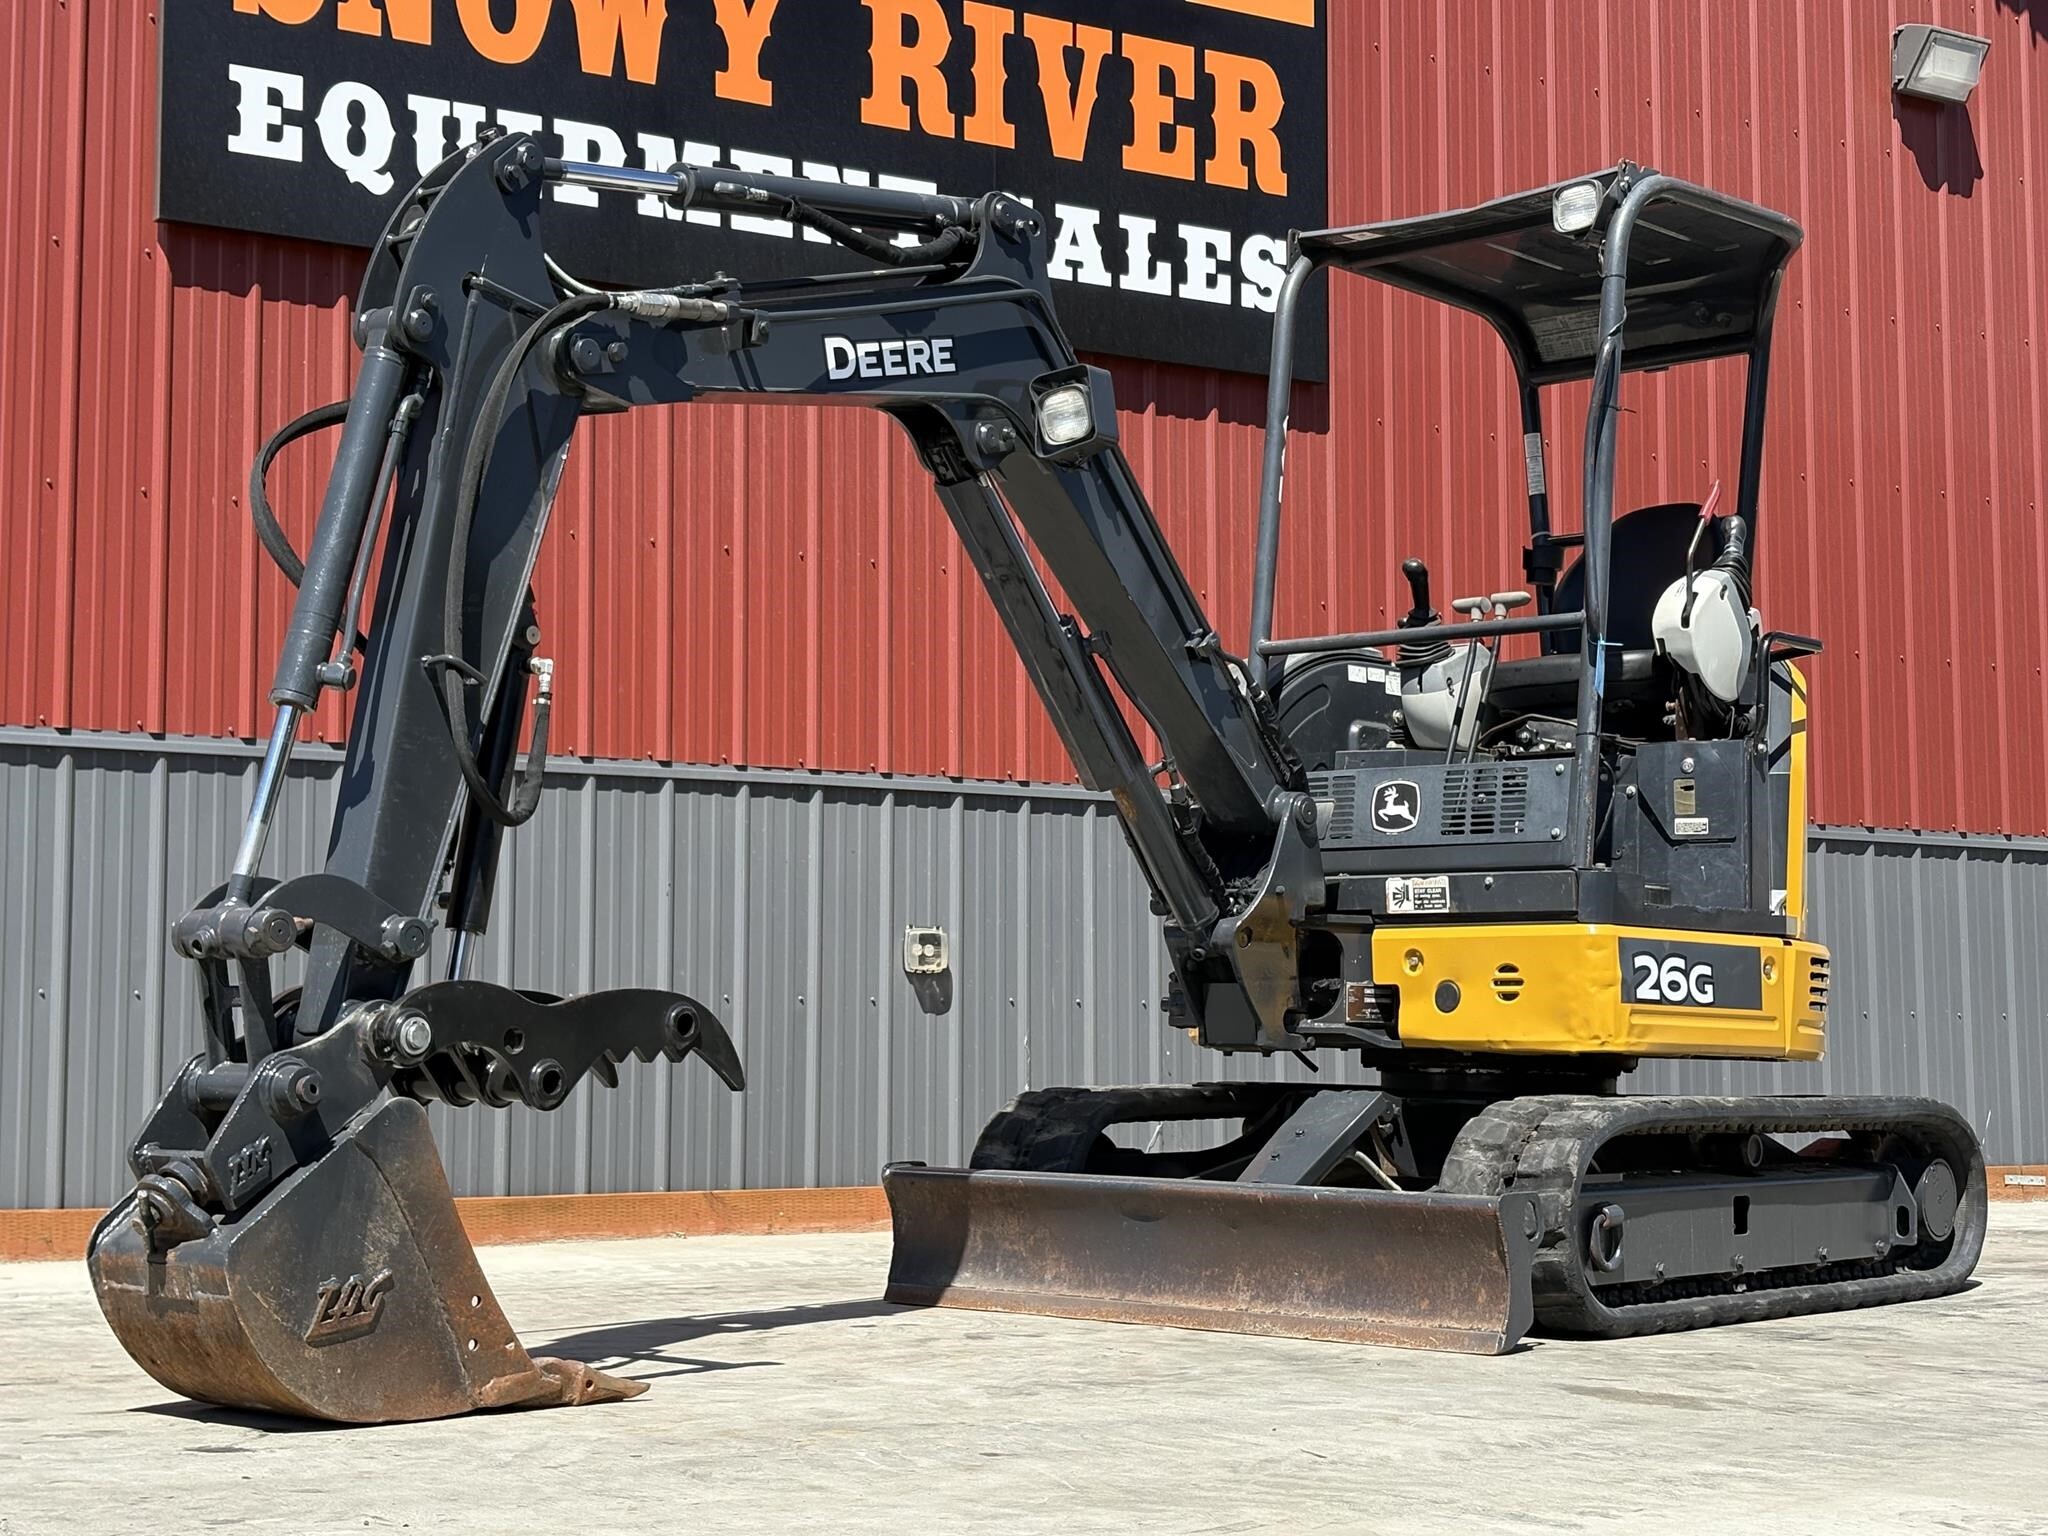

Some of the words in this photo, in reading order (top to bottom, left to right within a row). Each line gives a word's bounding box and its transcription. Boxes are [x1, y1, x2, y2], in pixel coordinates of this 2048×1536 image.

[860, 0, 1287, 197] RIVER
[1002, 192, 1288, 313] ALES
[823, 336, 957, 380] DEERE
[1633, 954, 1715, 1004] 26G
